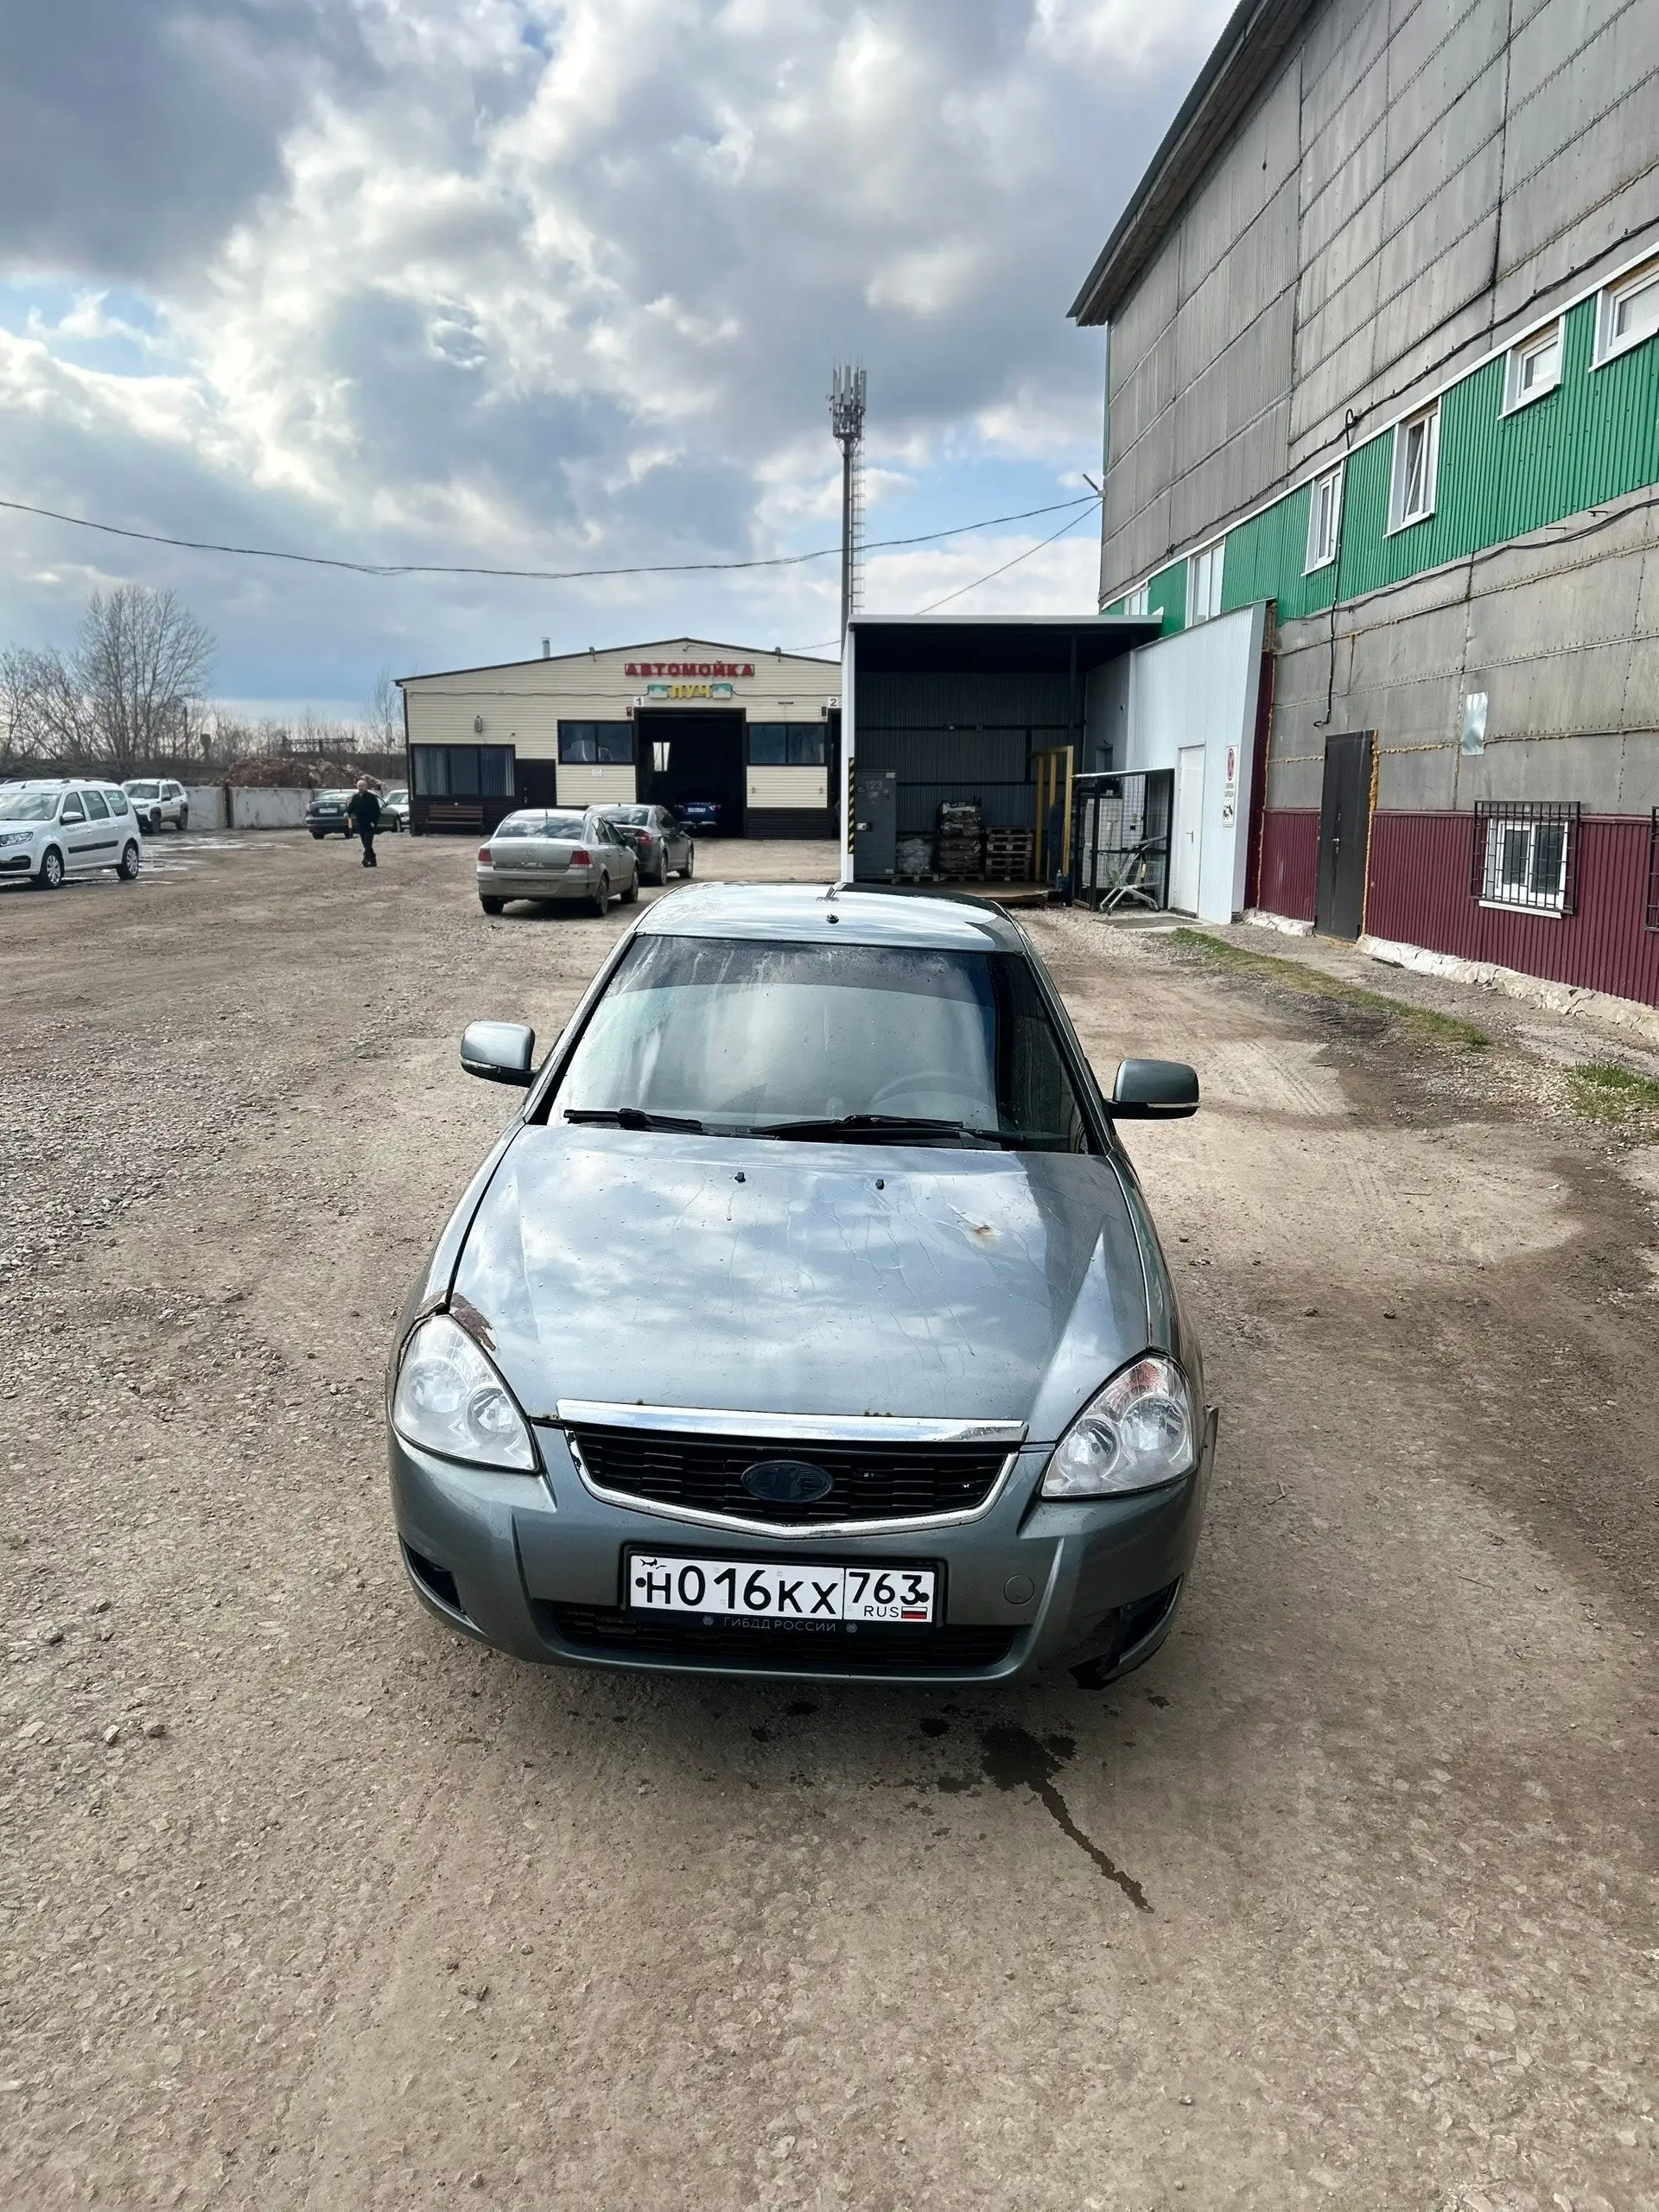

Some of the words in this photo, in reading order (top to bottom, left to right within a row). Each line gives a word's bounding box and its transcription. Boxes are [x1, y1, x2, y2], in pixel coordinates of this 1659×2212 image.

[626, 661, 753, 677] АВТОМОЙКА
[636, 697, 642, 706] 1
[830, 697, 837, 707] 2
[849, 1572, 924, 1605] 763
[863, 1605, 899, 1618] RUS
[722, 1617, 770, 1630] ГИБДД
[774, 1619, 836, 1633] РОССИИ
